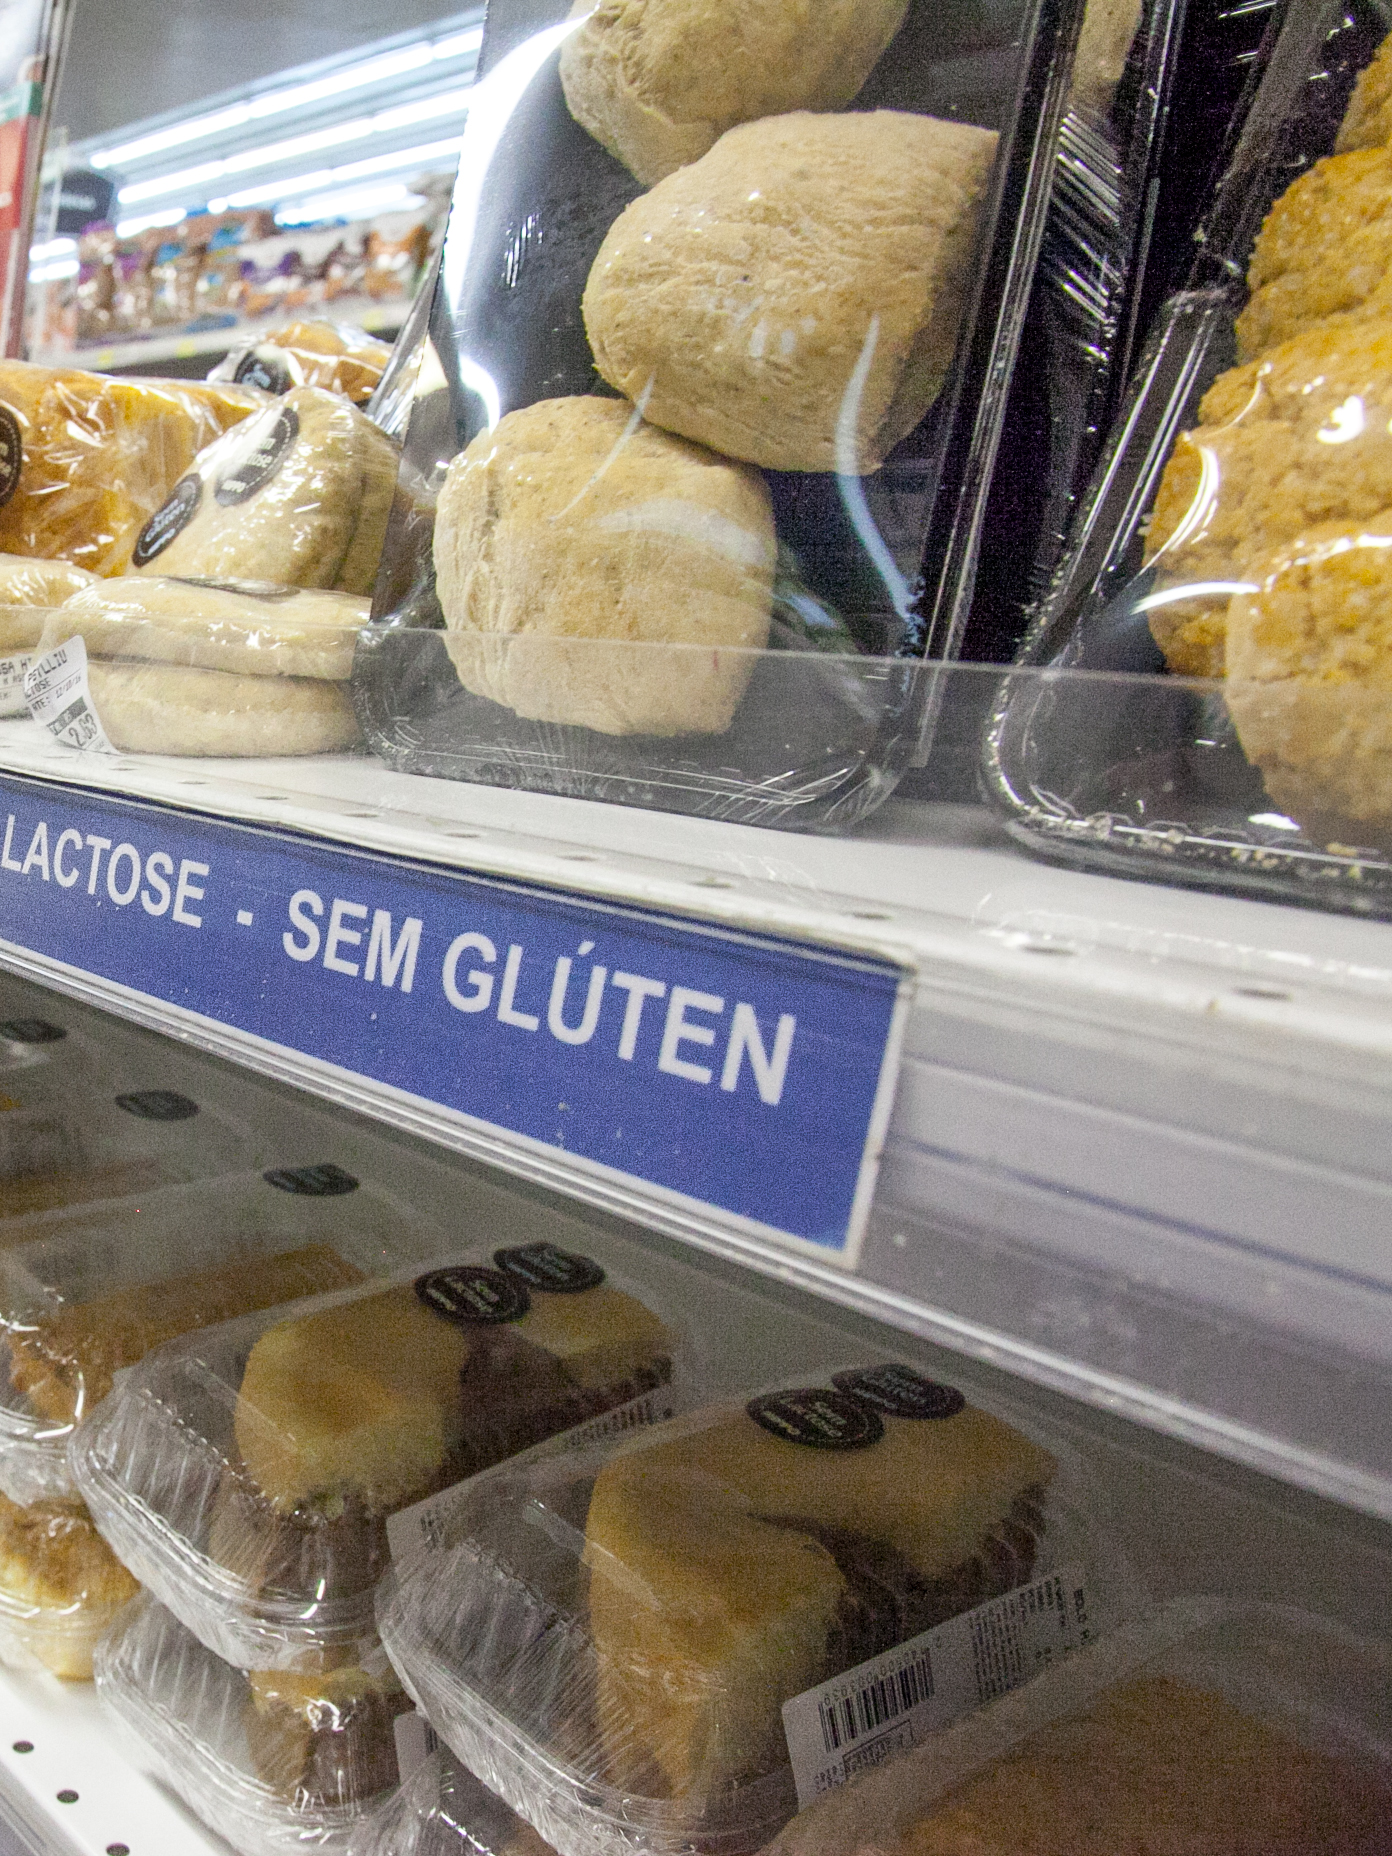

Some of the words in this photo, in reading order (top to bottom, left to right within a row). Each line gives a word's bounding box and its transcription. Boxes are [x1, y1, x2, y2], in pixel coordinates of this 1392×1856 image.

[1, 815, 210, 928] LACTOSE
[236, 909, 254, 927] -
[282, 888, 423, 992] SEM
[442, 931, 796, 1105] GLÚTEN
